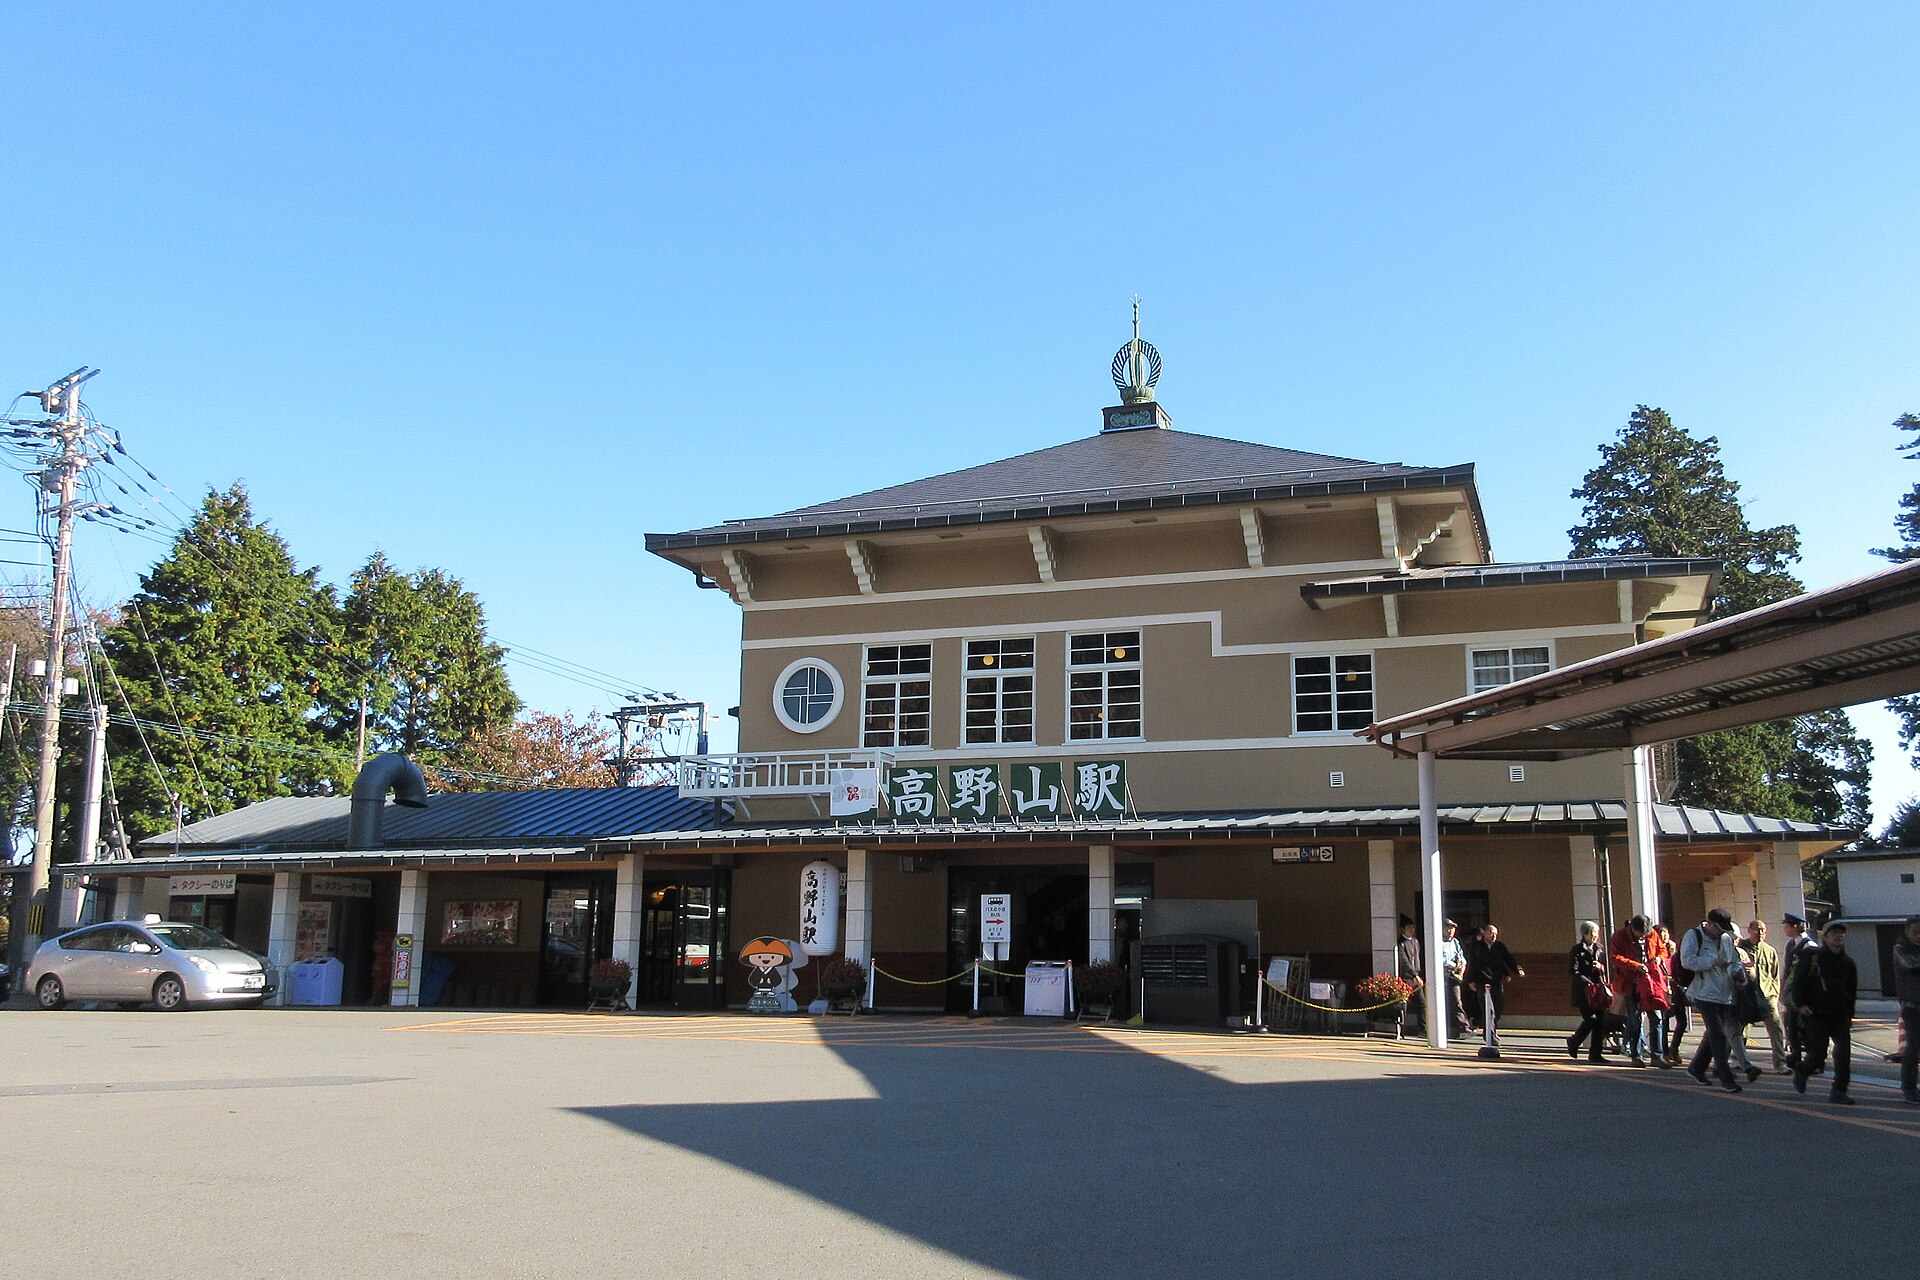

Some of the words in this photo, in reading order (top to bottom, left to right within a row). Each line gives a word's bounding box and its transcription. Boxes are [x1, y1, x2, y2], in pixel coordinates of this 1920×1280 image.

[892, 763, 1125, 818] 高野山駅
[181, 880, 234, 891] タクシーのりば
[802, 869, 819, 945] 高野山駅
